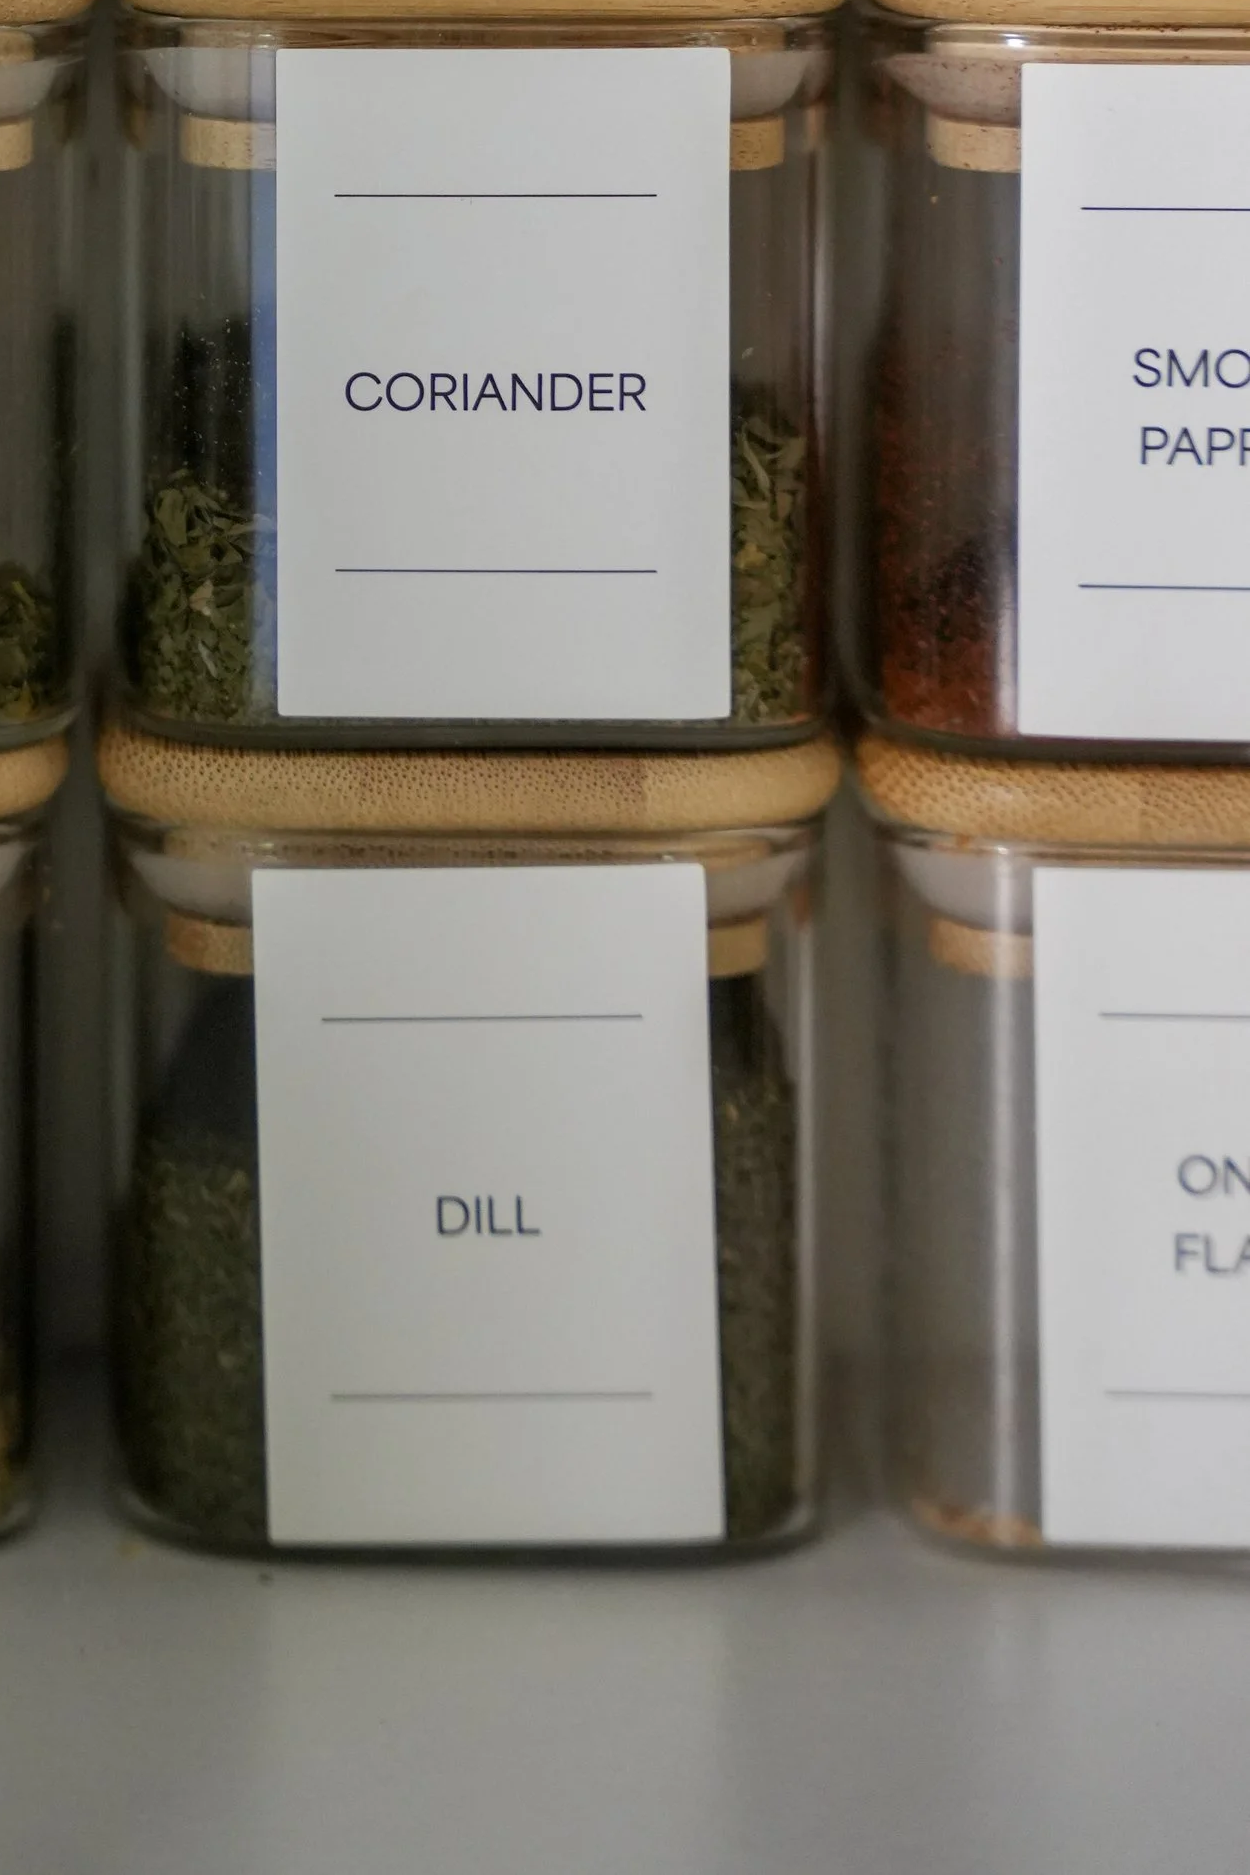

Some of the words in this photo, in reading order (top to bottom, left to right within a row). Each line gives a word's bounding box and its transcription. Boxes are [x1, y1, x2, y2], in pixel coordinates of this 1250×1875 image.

[1132, 348, 1250, 389] SMO
[345, 372, 646, 412] CORIANDER
[436, 1196, 540, 1237] DILL
